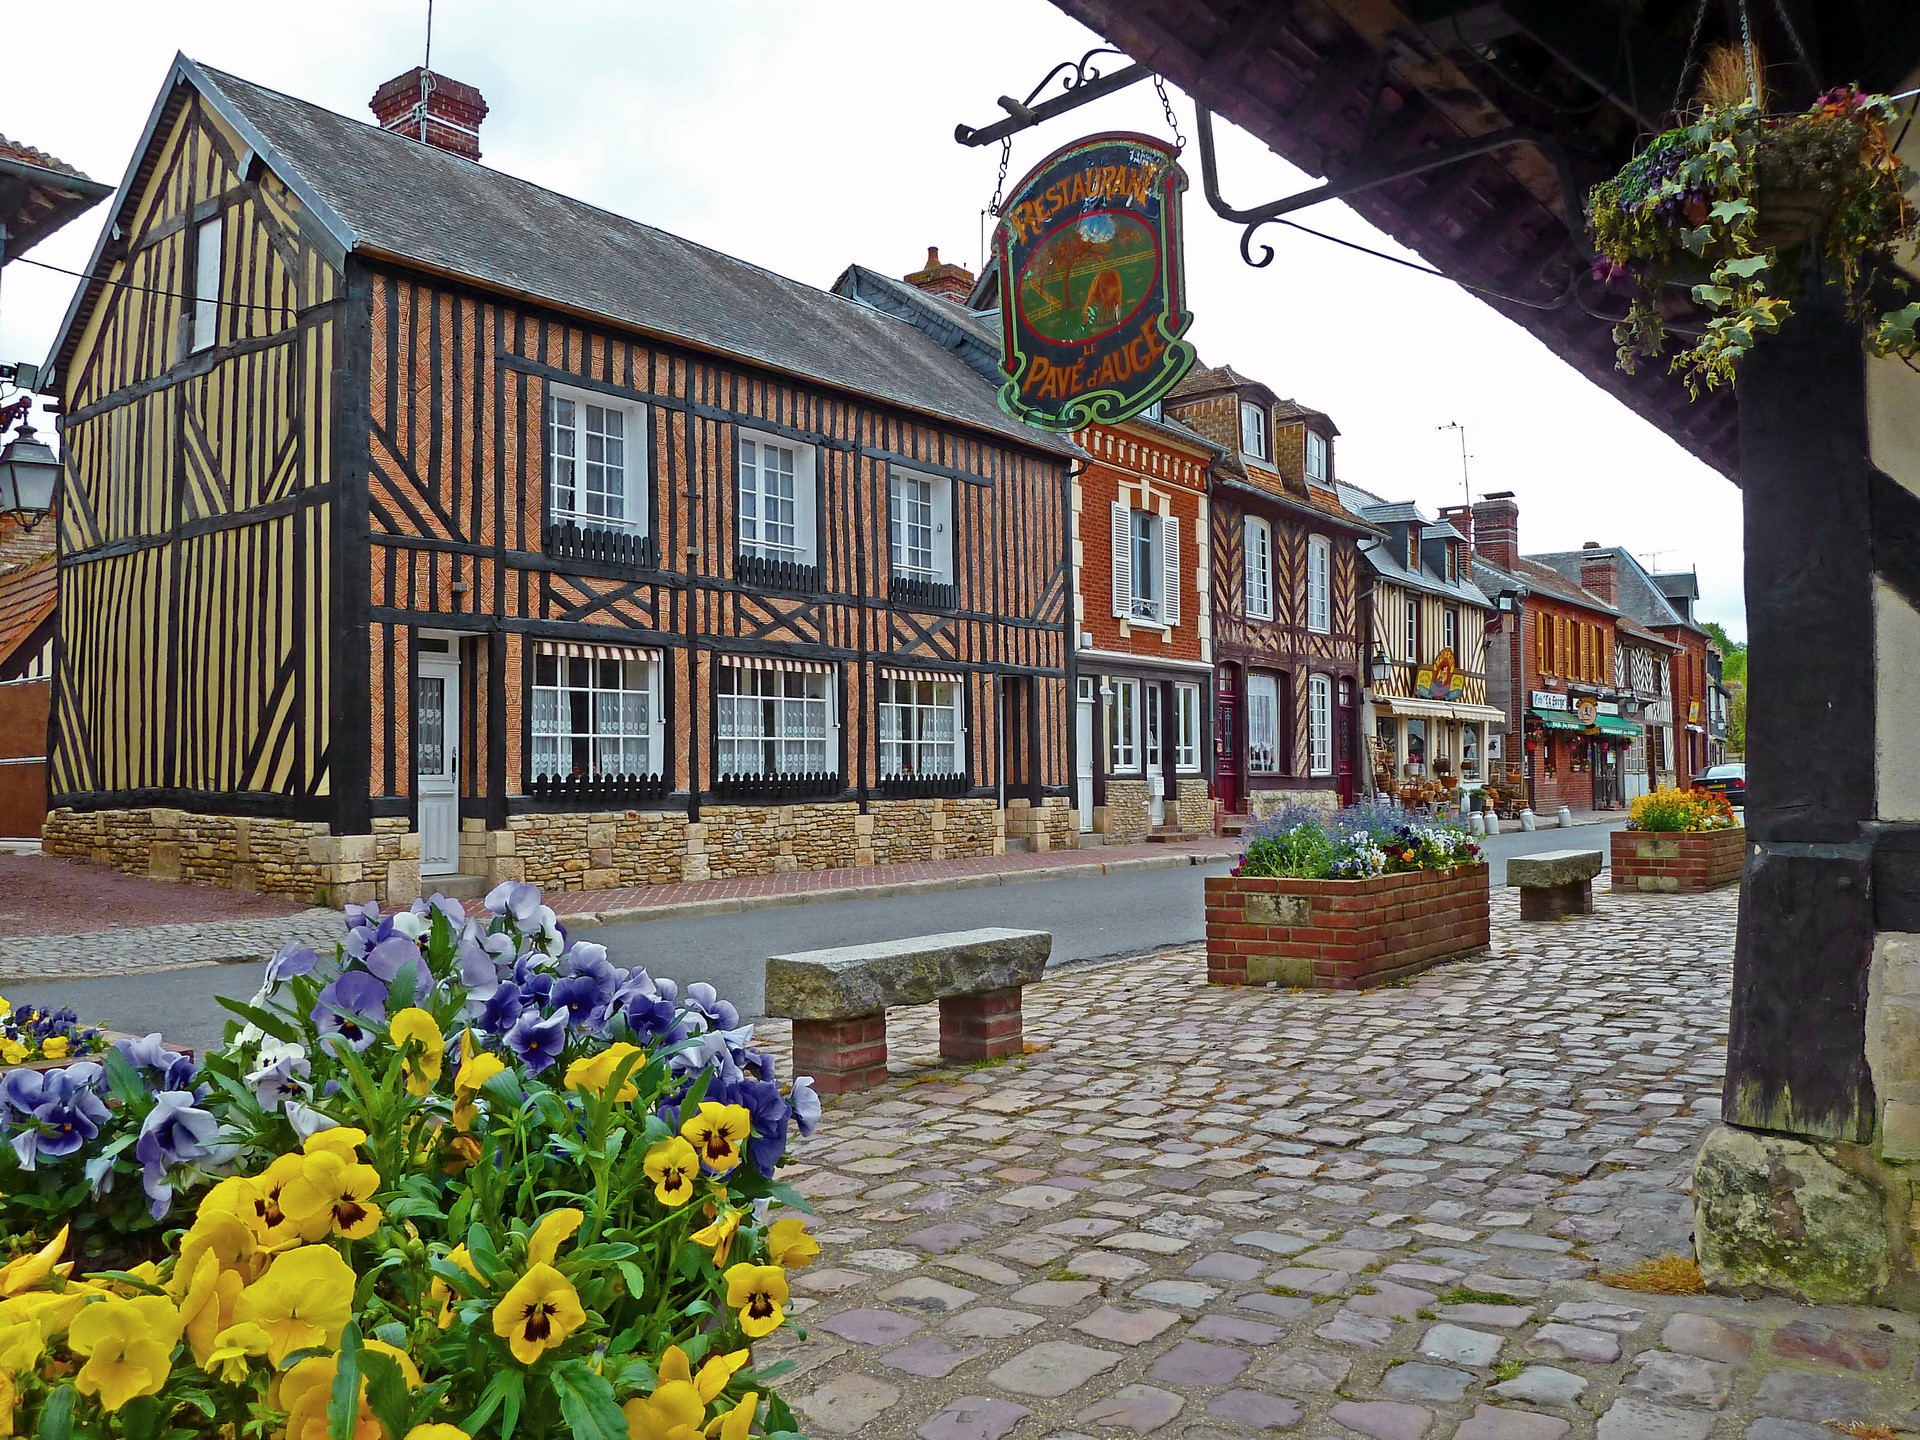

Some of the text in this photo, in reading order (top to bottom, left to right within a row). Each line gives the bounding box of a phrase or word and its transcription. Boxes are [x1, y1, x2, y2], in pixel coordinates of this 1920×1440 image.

[1011, 163, 1160, 244] RESTAURANT
[1021, 315, 1167, 399] PAVÉ d'AUGE
[1083, 343, 1096, 356] LE
